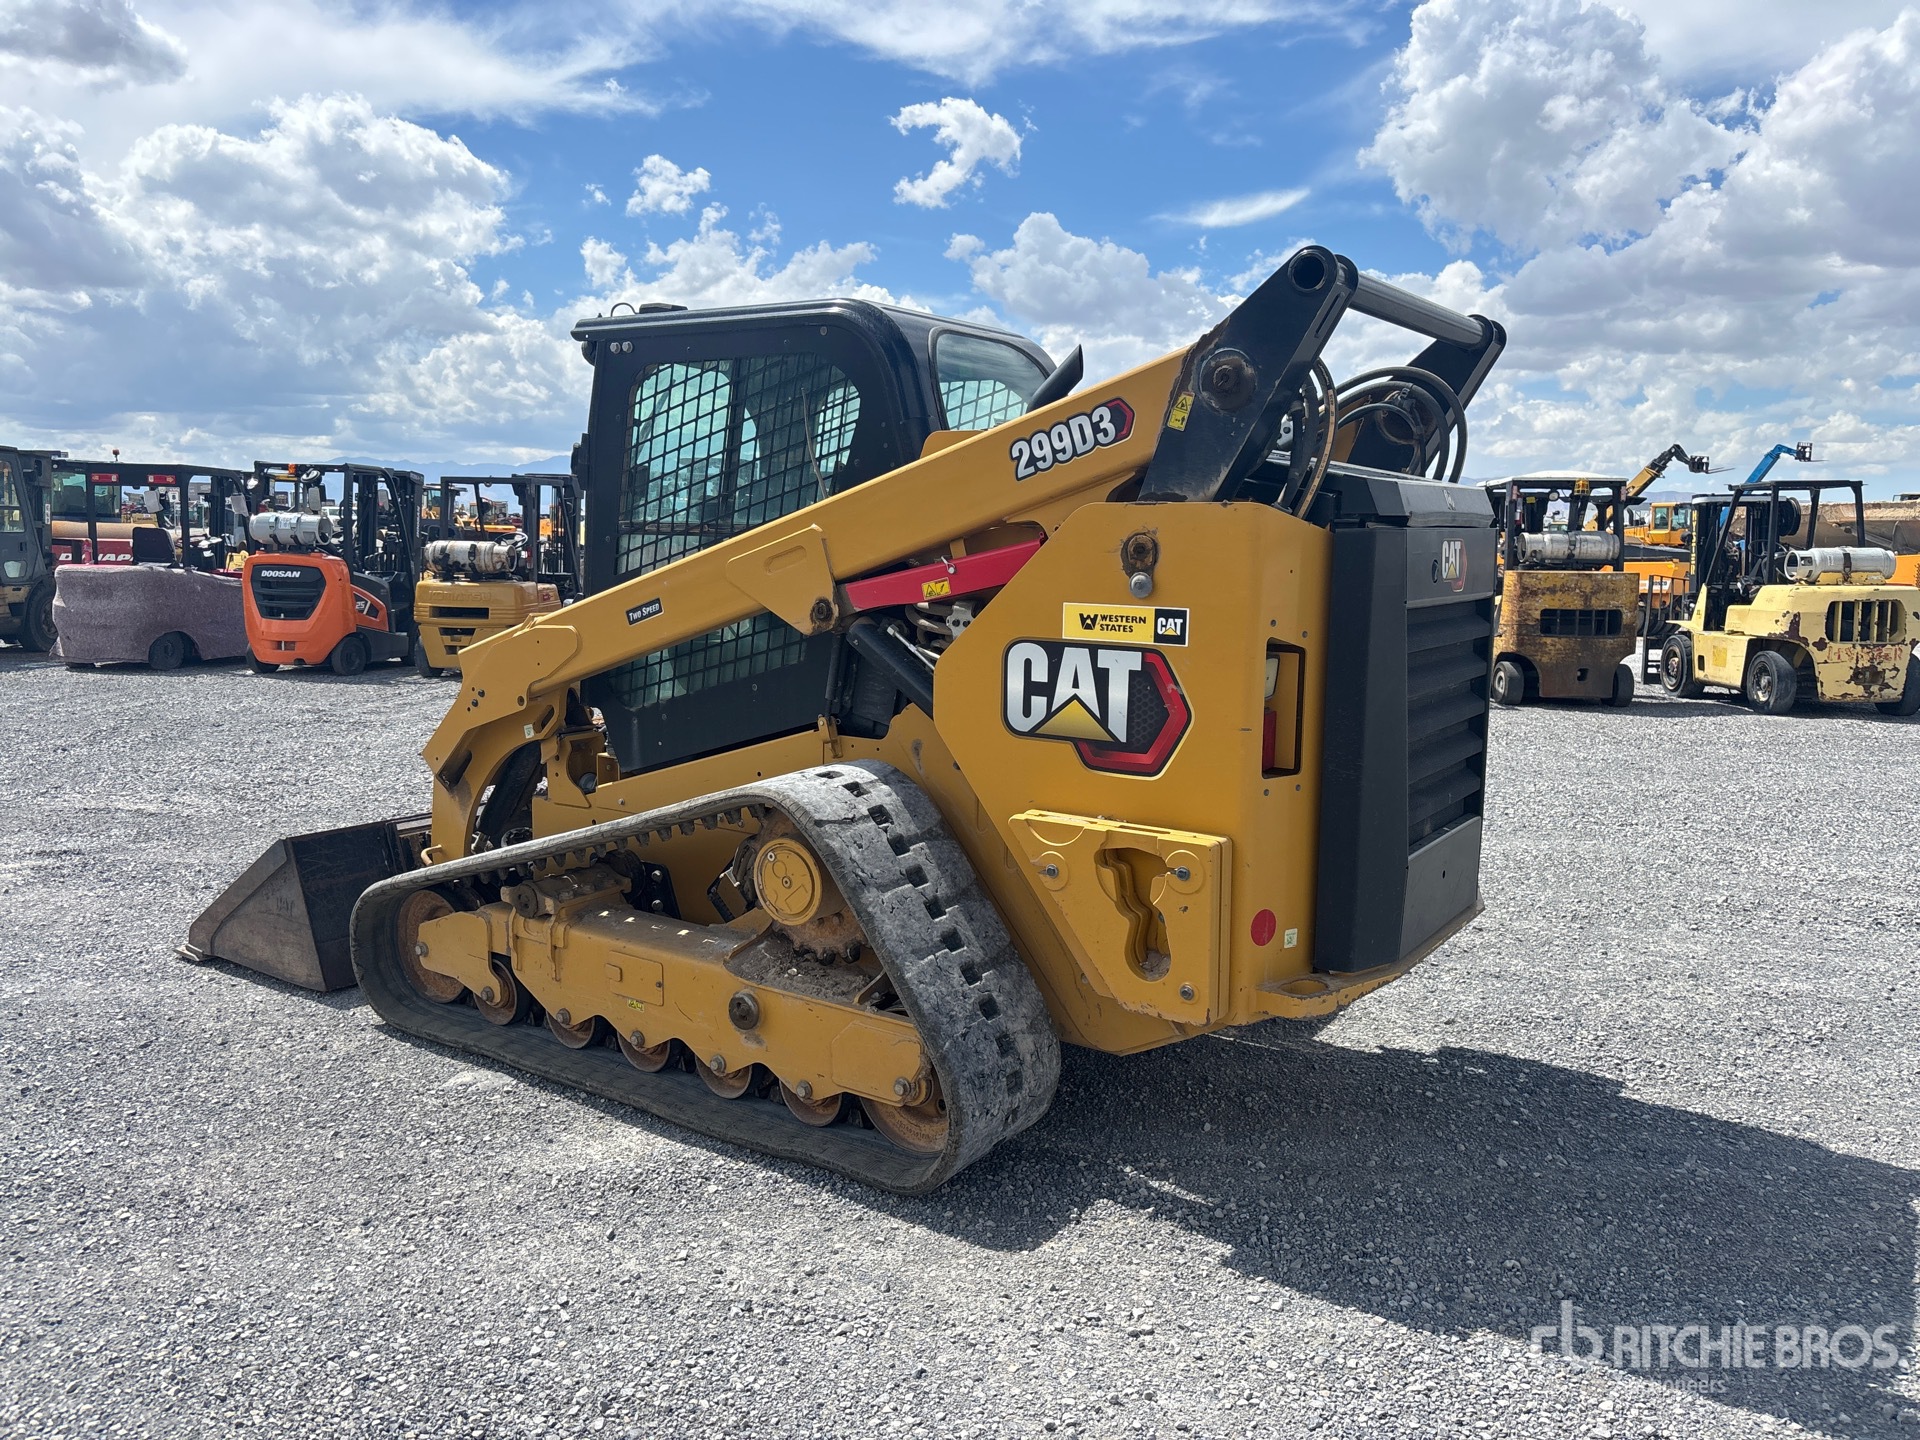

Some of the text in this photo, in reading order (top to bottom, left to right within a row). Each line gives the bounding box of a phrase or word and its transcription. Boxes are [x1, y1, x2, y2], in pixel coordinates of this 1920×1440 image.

[1012, 406, 1116, 478] 299D3
[1442, 540, 1461, 579] CAT
[261, 570, 301, 578] DOOSAN
[1099, 624, 1134, 633] STATES
[1100, 614, 1147, 625] WESTERN
[1157, 617, 1184, 636] CAT
[1007, 642, 1142, 743] CAT
